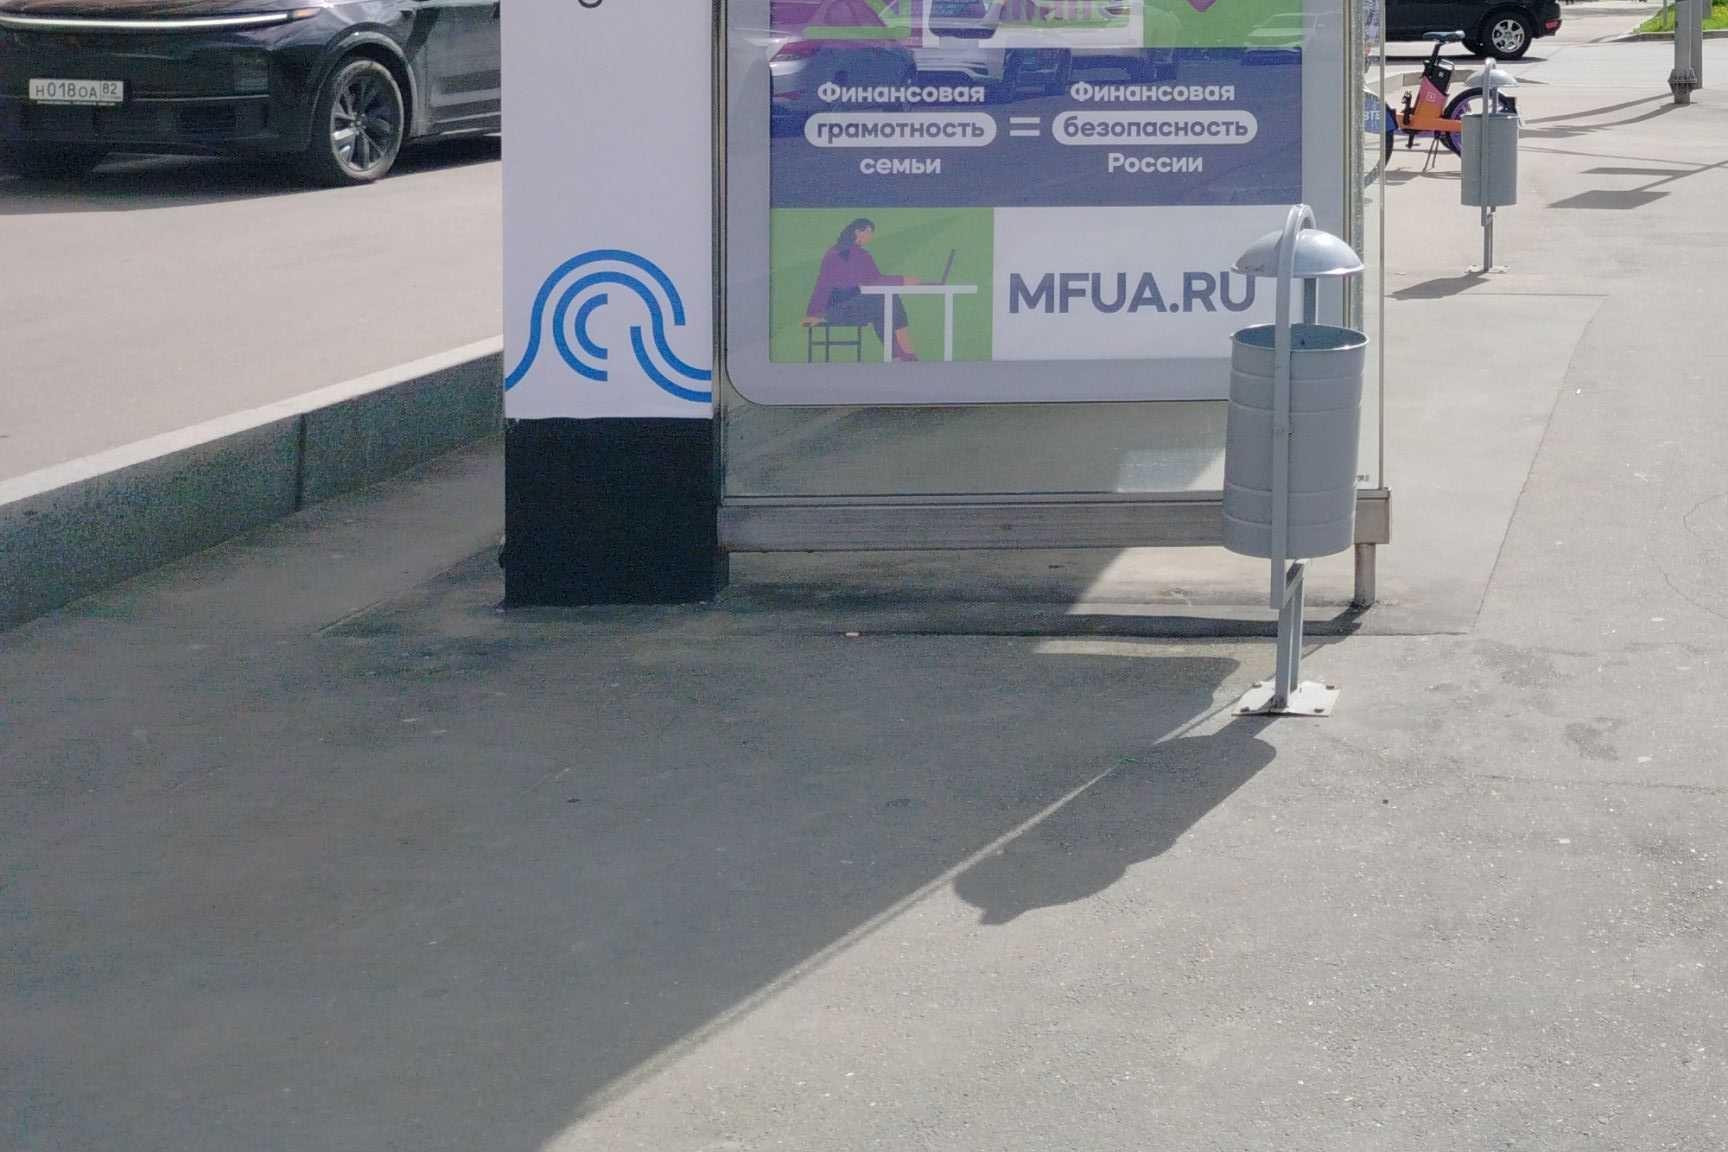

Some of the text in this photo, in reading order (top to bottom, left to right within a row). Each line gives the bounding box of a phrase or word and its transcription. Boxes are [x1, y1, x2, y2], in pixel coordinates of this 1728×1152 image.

[817, 81, 985, 105] Финансовая
[1070, 80, 1236, 103] Финансовая
[816, 119, 985, 145] грамотность
[1063, 113, 1249, 139] безопасность
[859, 158, 942, 175] семьи
[1108, 151, 1203, 173] России
[1008, 271, 1256, 314] MFUA.RU
